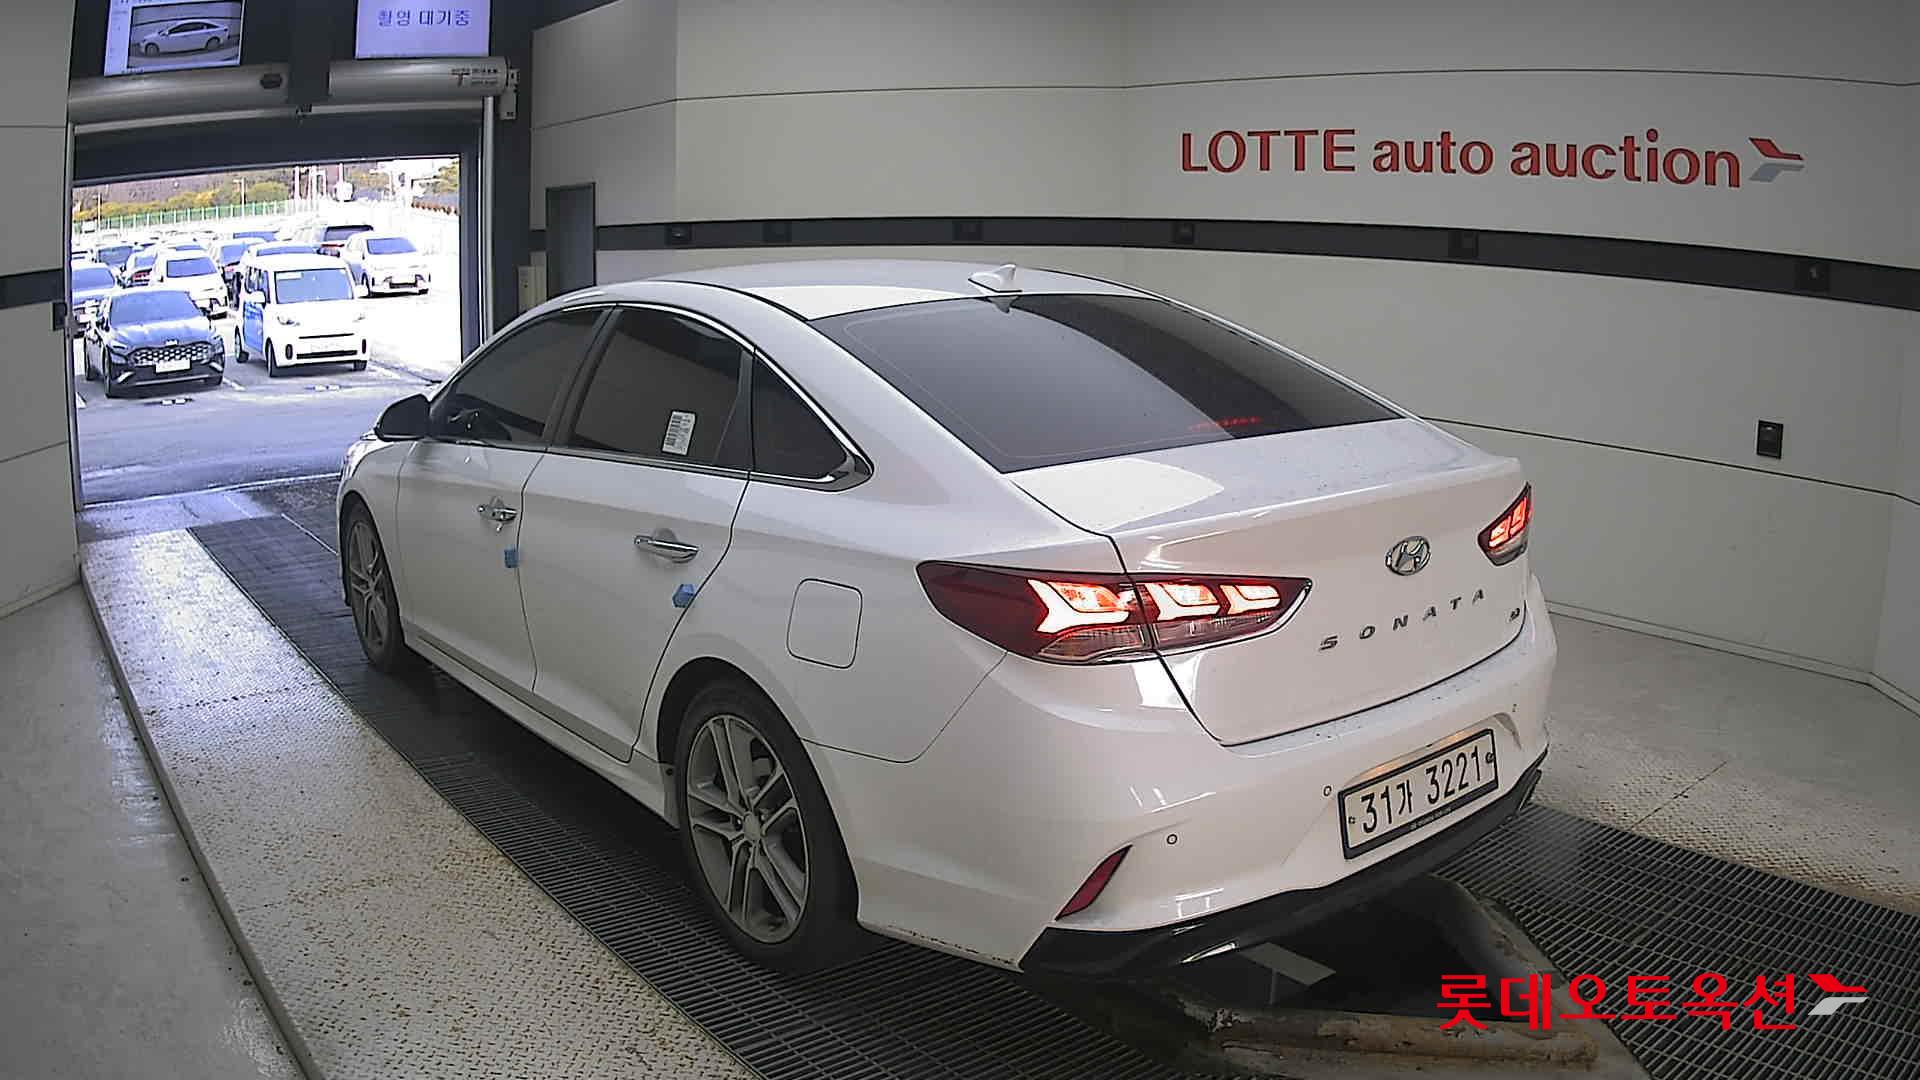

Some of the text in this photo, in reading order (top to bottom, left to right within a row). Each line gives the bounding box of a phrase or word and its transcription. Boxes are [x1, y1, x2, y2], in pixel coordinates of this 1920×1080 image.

[419, 9, 470, 26] 대기중
[1180, 128, 1741, 188] LOTTE auto auction
[1318, 588, 1485, 651] SONATA
[1361, 779, 1412, 833] 31가
[1426, 745, 1481, 805] 3221
